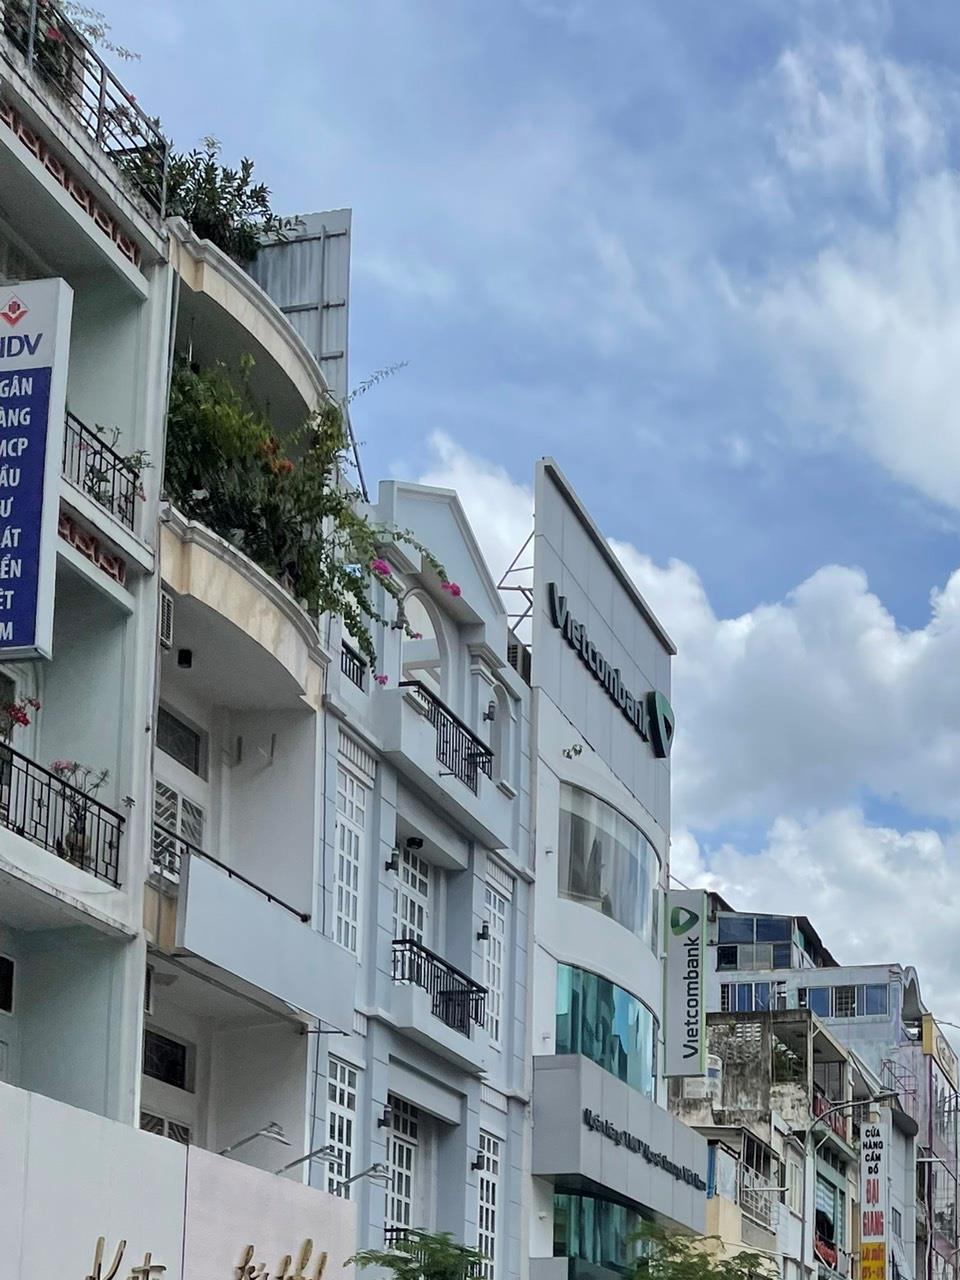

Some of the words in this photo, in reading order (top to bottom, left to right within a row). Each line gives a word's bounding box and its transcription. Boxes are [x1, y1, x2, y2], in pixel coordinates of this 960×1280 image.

[0, 333, 43, 358] IDV
[0, 375, 33, 398] GÂN
[0, 407, 31, 428] ÀNG
[0, 438, 28, 457] MCP
[0, 525, 22, 549] ÁT
[548, 582, 652, 743] Vietcombank
[682, 935, 700, 1060] Vietcombank
